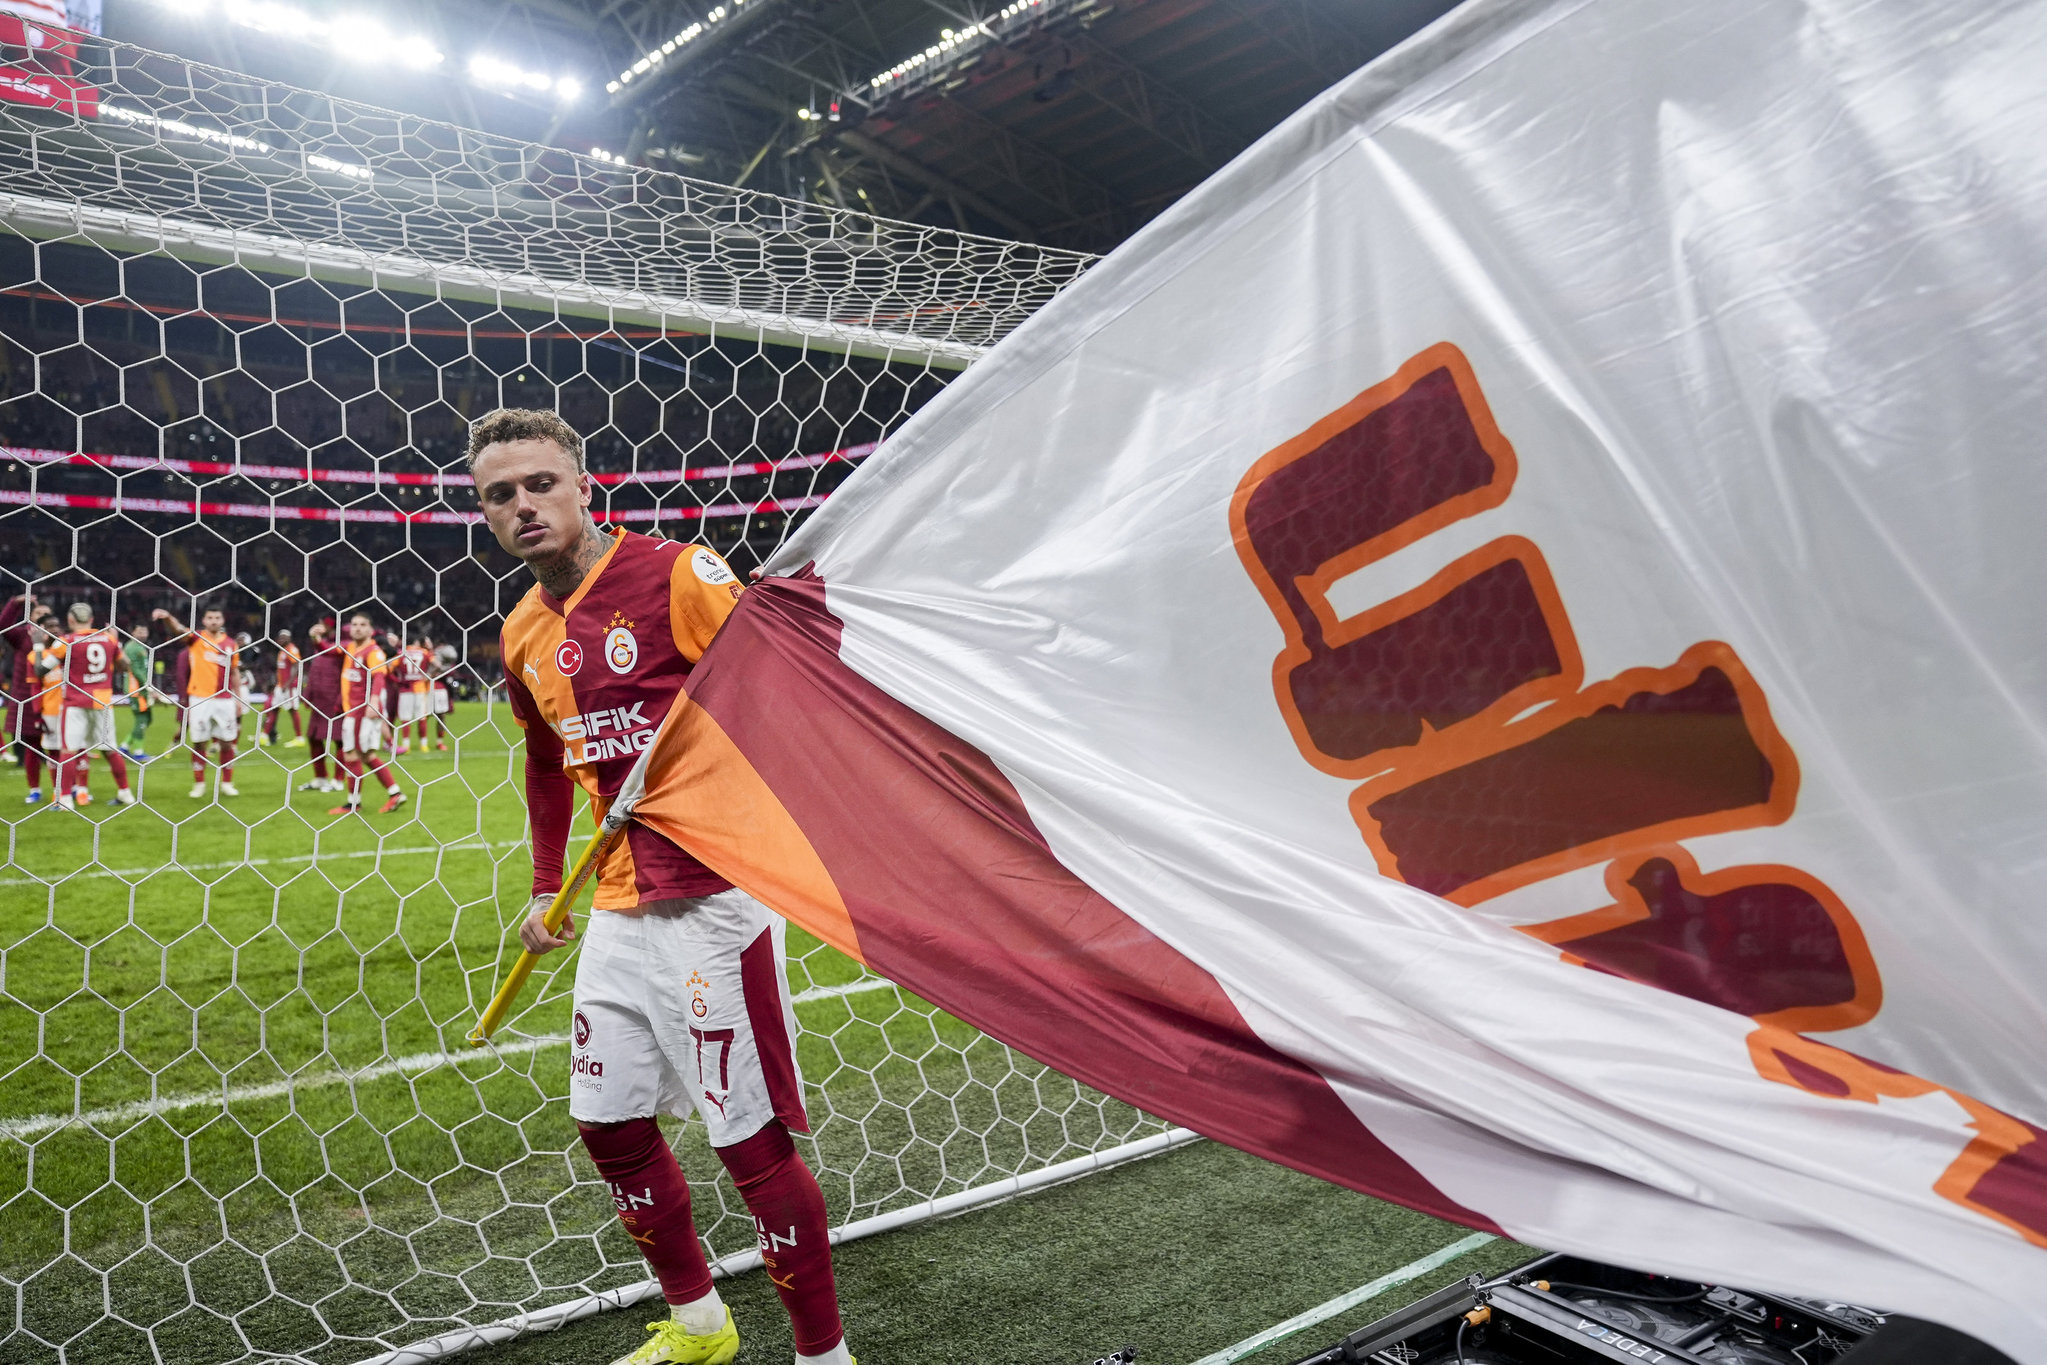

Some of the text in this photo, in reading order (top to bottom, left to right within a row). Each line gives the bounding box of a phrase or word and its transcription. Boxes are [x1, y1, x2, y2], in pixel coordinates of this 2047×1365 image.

[86, 643, 107, 673] 9
[564, 728, 656, 767] LDiNG
[1576, 1319, 1667, 1364] LEDECA
